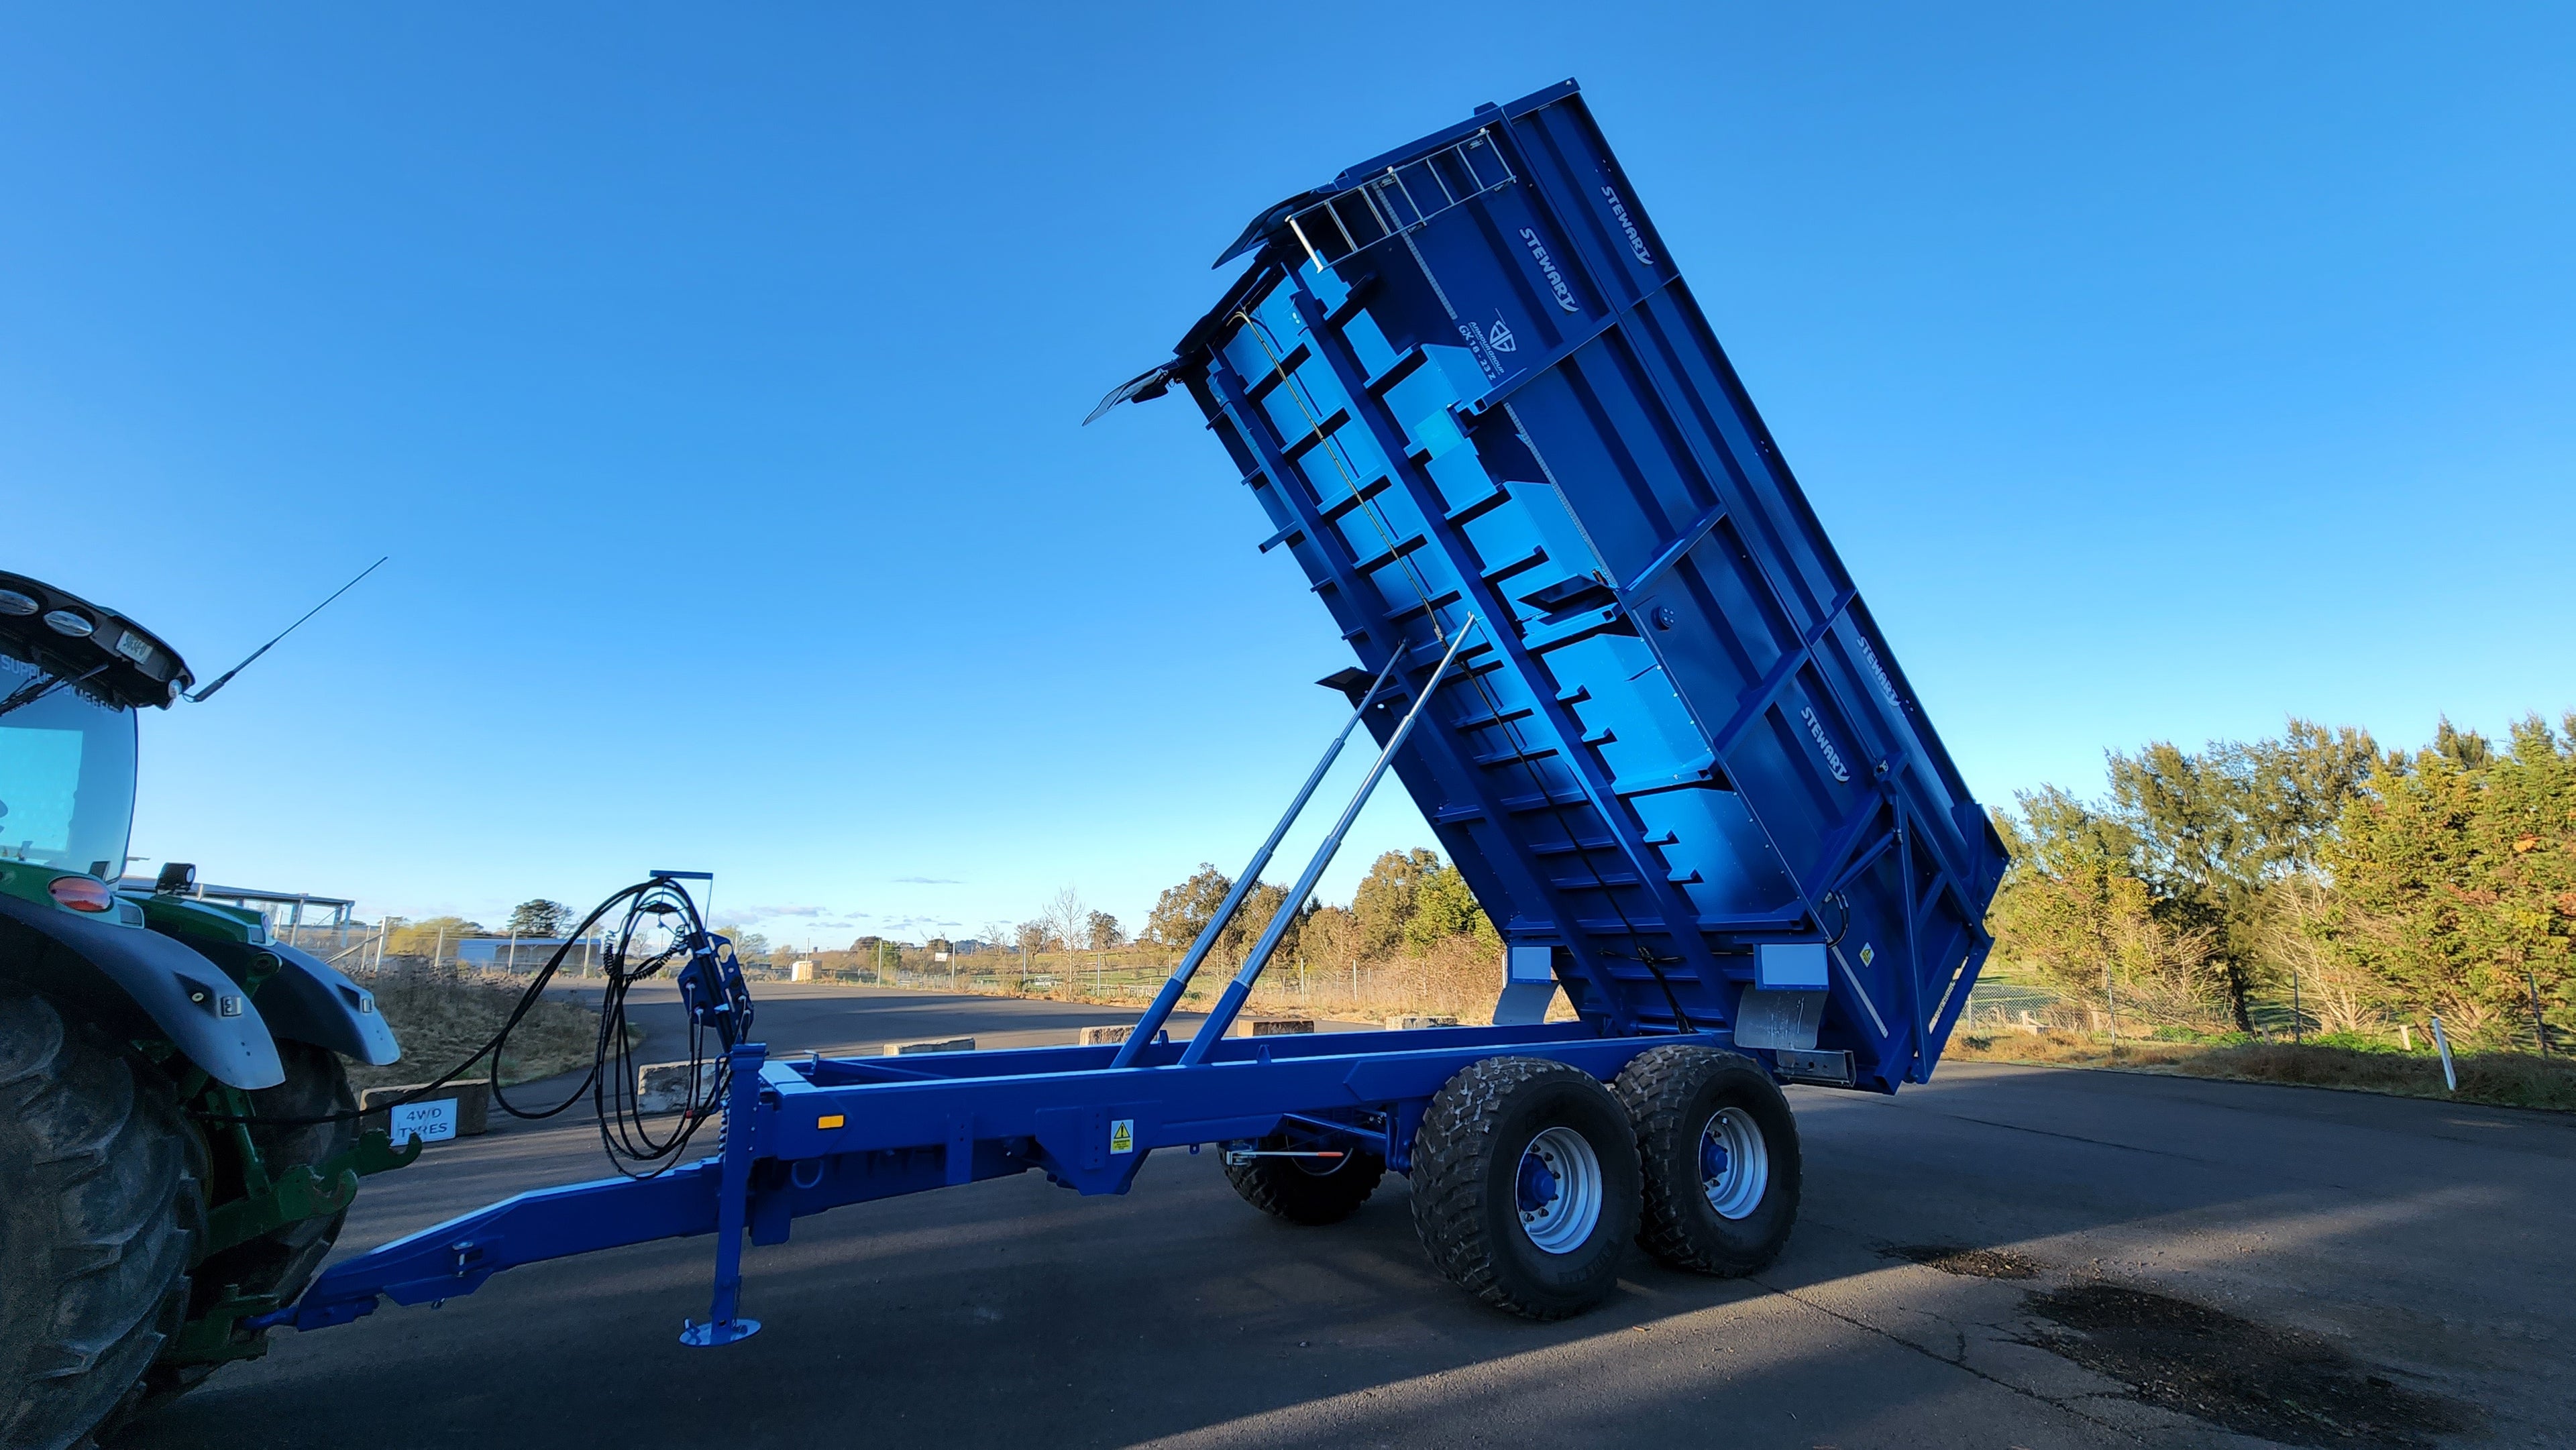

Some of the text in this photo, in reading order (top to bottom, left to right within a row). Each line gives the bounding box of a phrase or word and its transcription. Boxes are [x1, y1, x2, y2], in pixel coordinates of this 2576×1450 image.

[1601, 186, 1654, 265] STEWART
[1519, 228, 1579, 312] STEWART
[1857, 636, 1901, 707] STEWART
[1801, 706, 1850, 781] STEWART
[406, 1108, 441, 1121] 4WD
